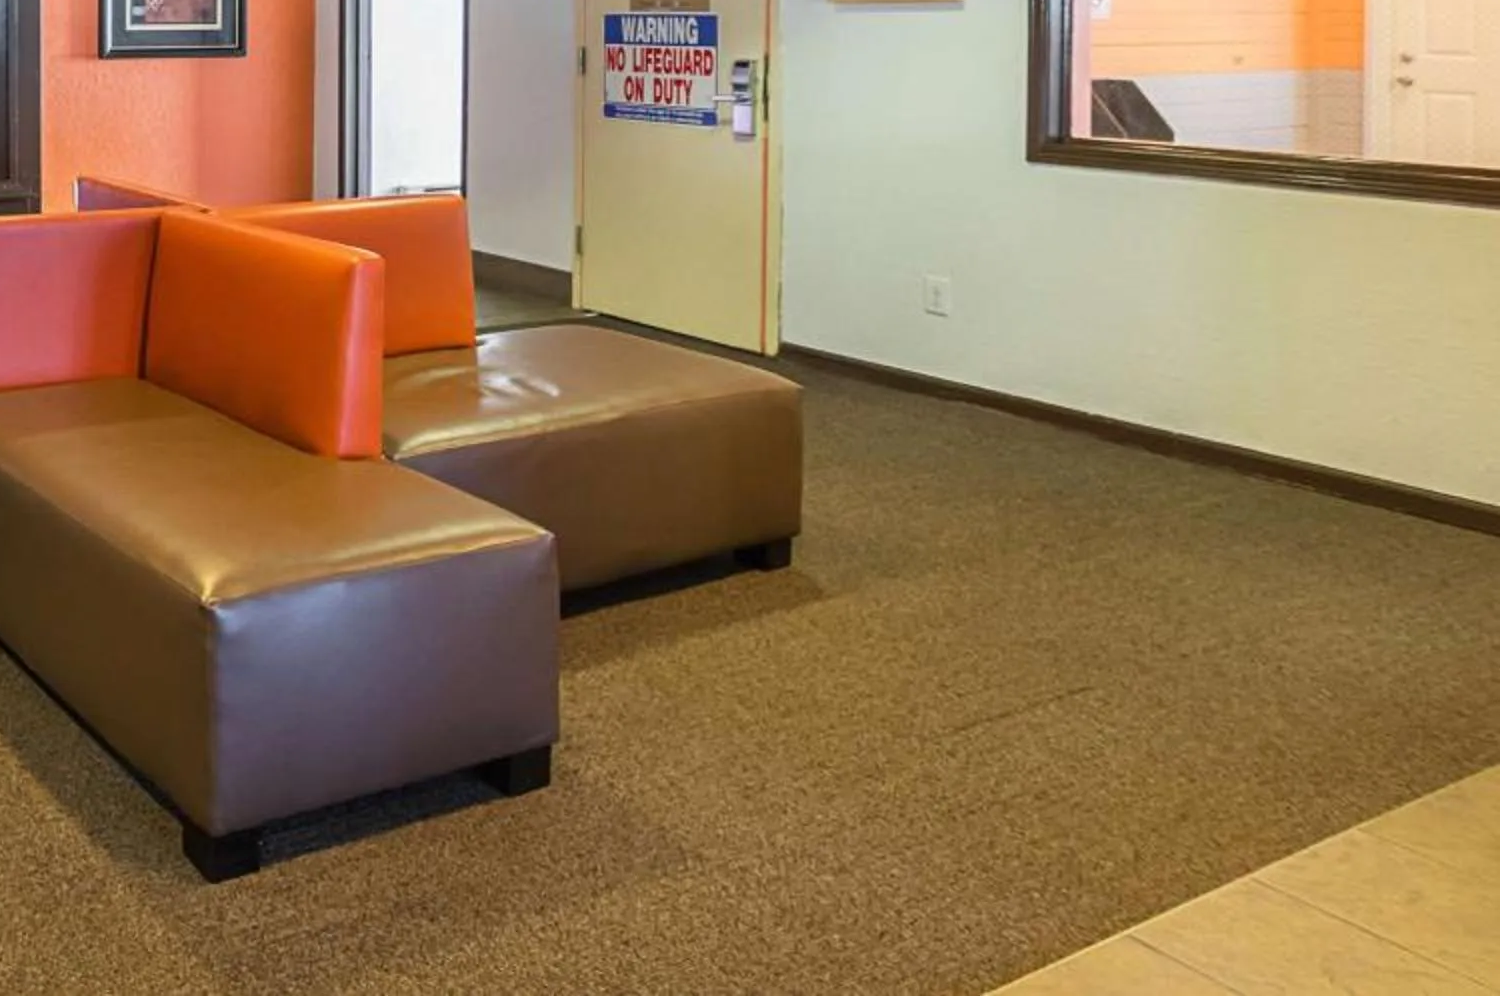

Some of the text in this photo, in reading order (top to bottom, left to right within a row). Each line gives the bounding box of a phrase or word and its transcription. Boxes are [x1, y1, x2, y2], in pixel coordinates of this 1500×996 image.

[621, 16, 699, 45] WARNING
[607, 47, 713, 77] NO LIFEGUARD
[624, 76, 692, 105] ON DUTY
